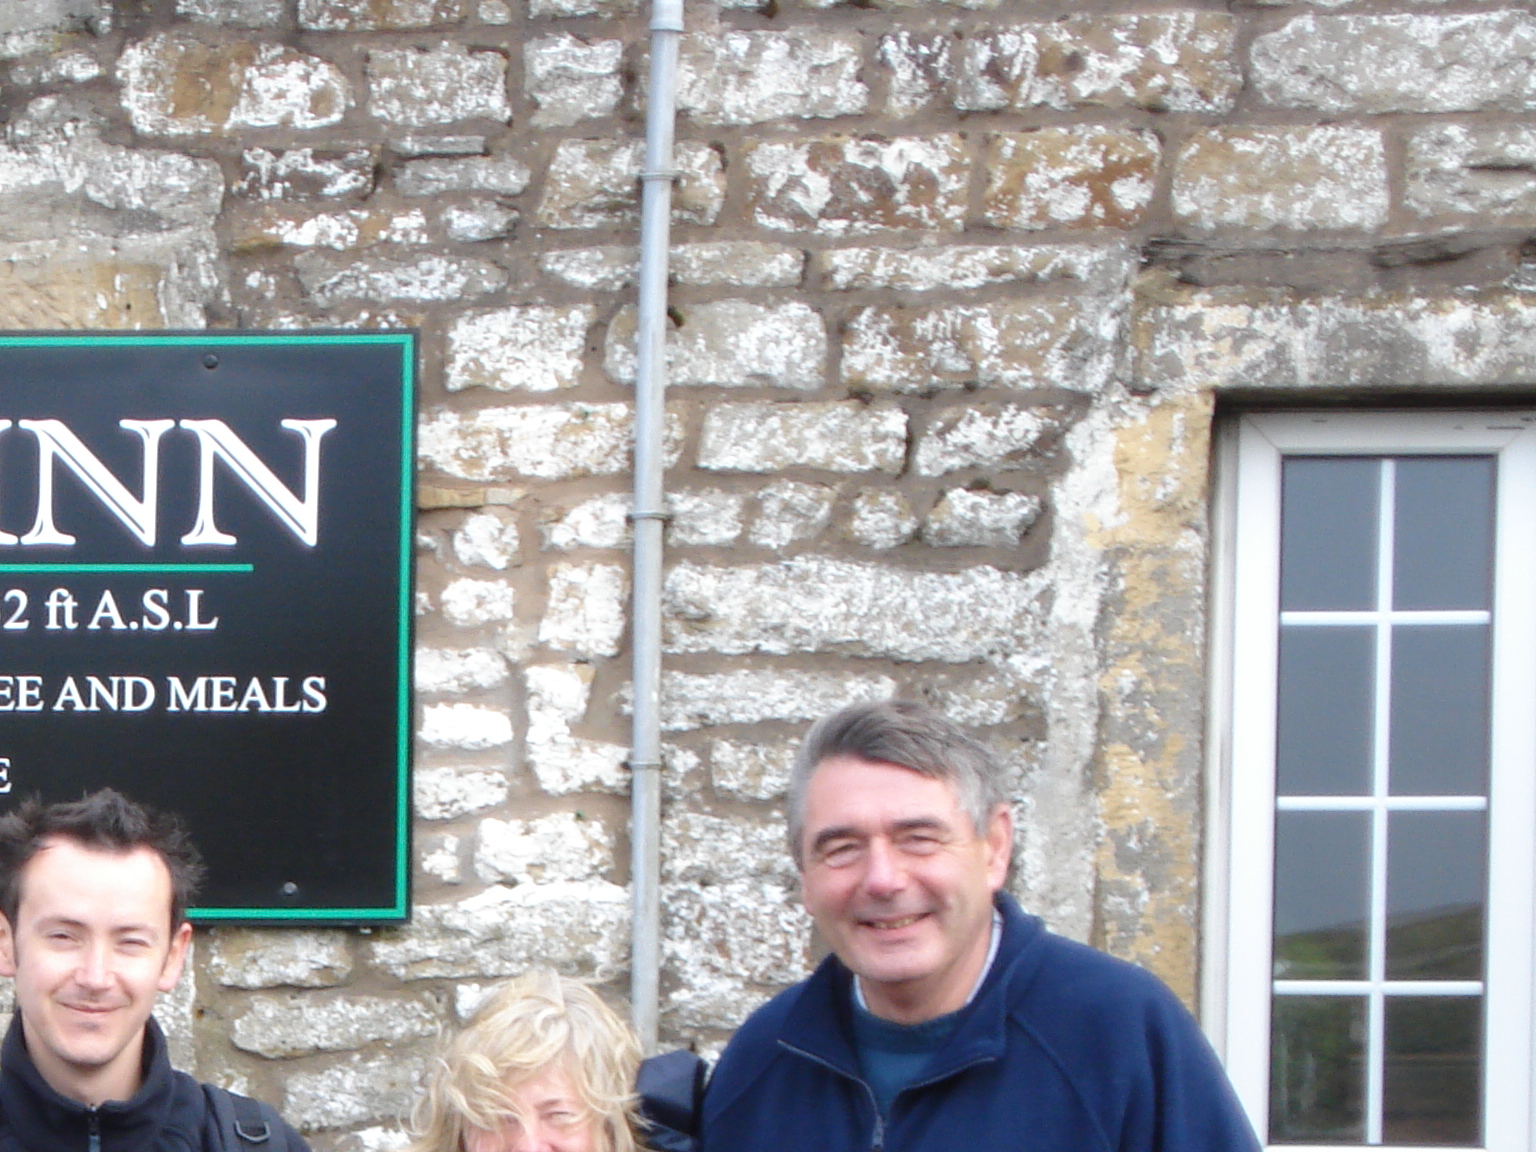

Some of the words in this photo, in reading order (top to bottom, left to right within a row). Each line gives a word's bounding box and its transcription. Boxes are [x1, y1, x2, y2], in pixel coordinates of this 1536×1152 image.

[45, 588, 78, 629] ft
[88, 589, 218, 629] A.S.L
[53, 676, 155, 711] AND
[167, 677, 326, 712] MEALS
